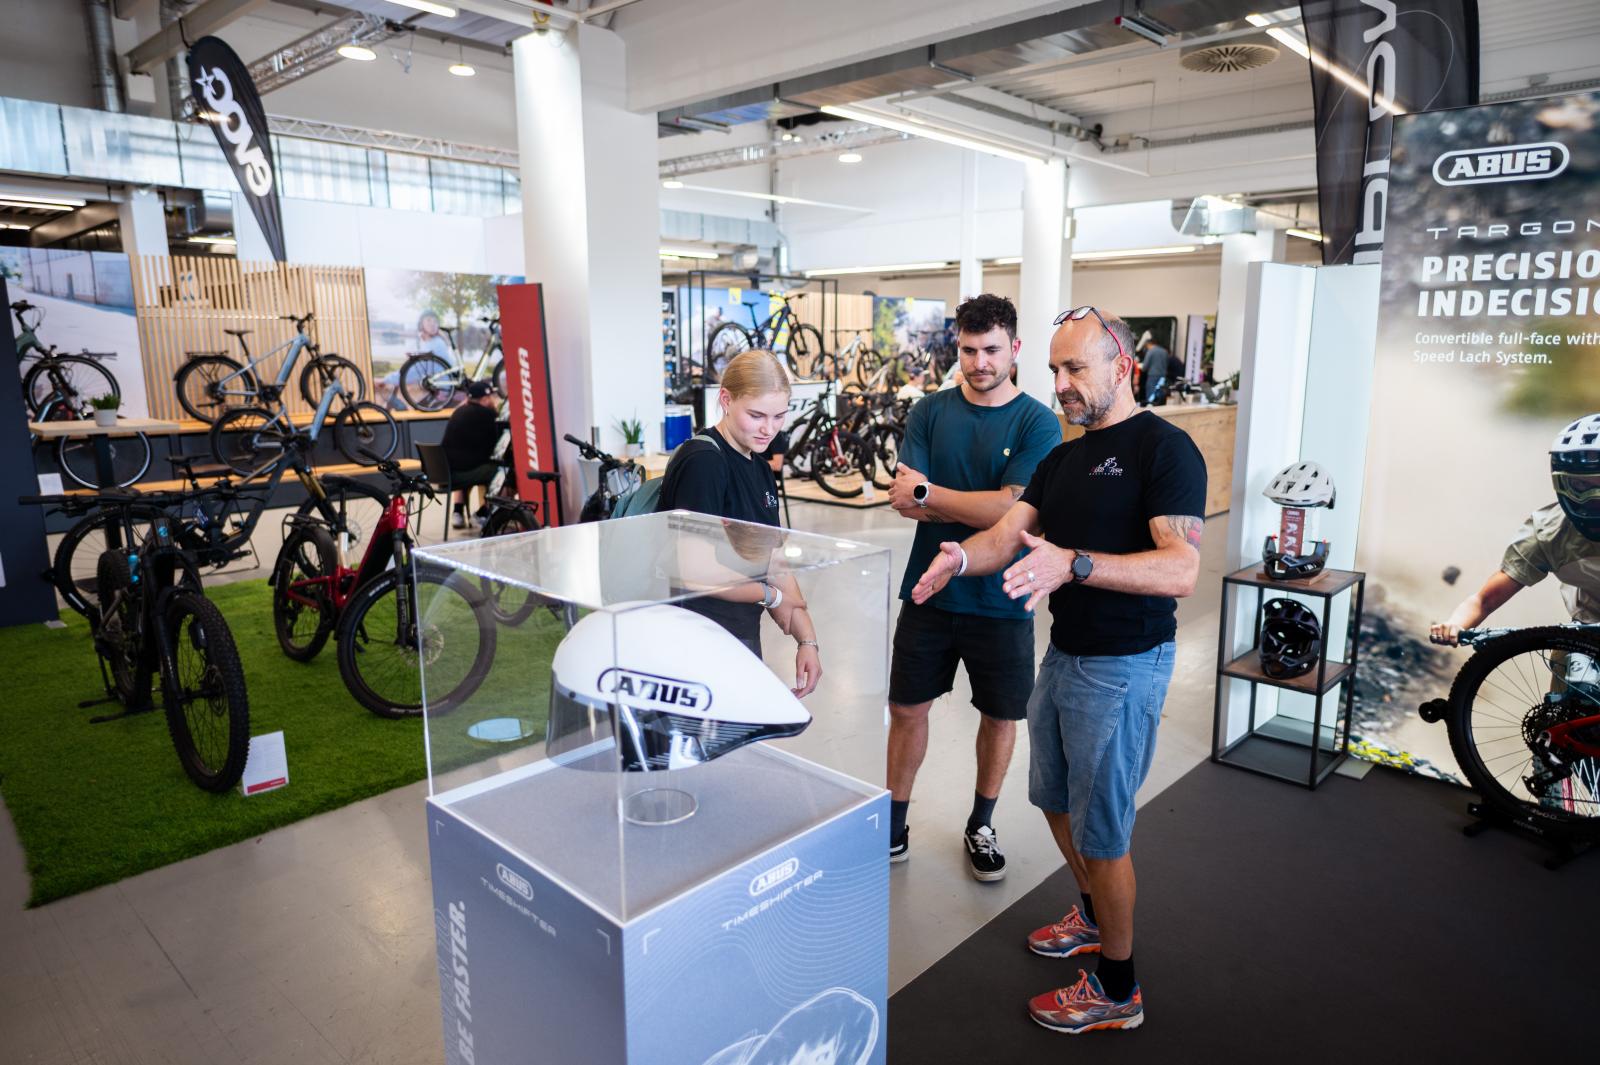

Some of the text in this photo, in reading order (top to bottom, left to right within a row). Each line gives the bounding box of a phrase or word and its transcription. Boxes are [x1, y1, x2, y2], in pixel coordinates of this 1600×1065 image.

[1448, 149, 1552, 179] ABUS
[1417, 287, 1600, 317] INDECISI
[1415, 332, 1600, 346] Convertible full-face with
[1413, 350, 1553, 365] Speed Lach System.
[518, 347, 540, 472] WINORA
[610, 675, 699, 708] ABUS
[755, 861, 794, 892] ABUS
[721, 870, 824, 931] TIMESHIFTER
[448, 901, 475, 1065] BE FASTER.
